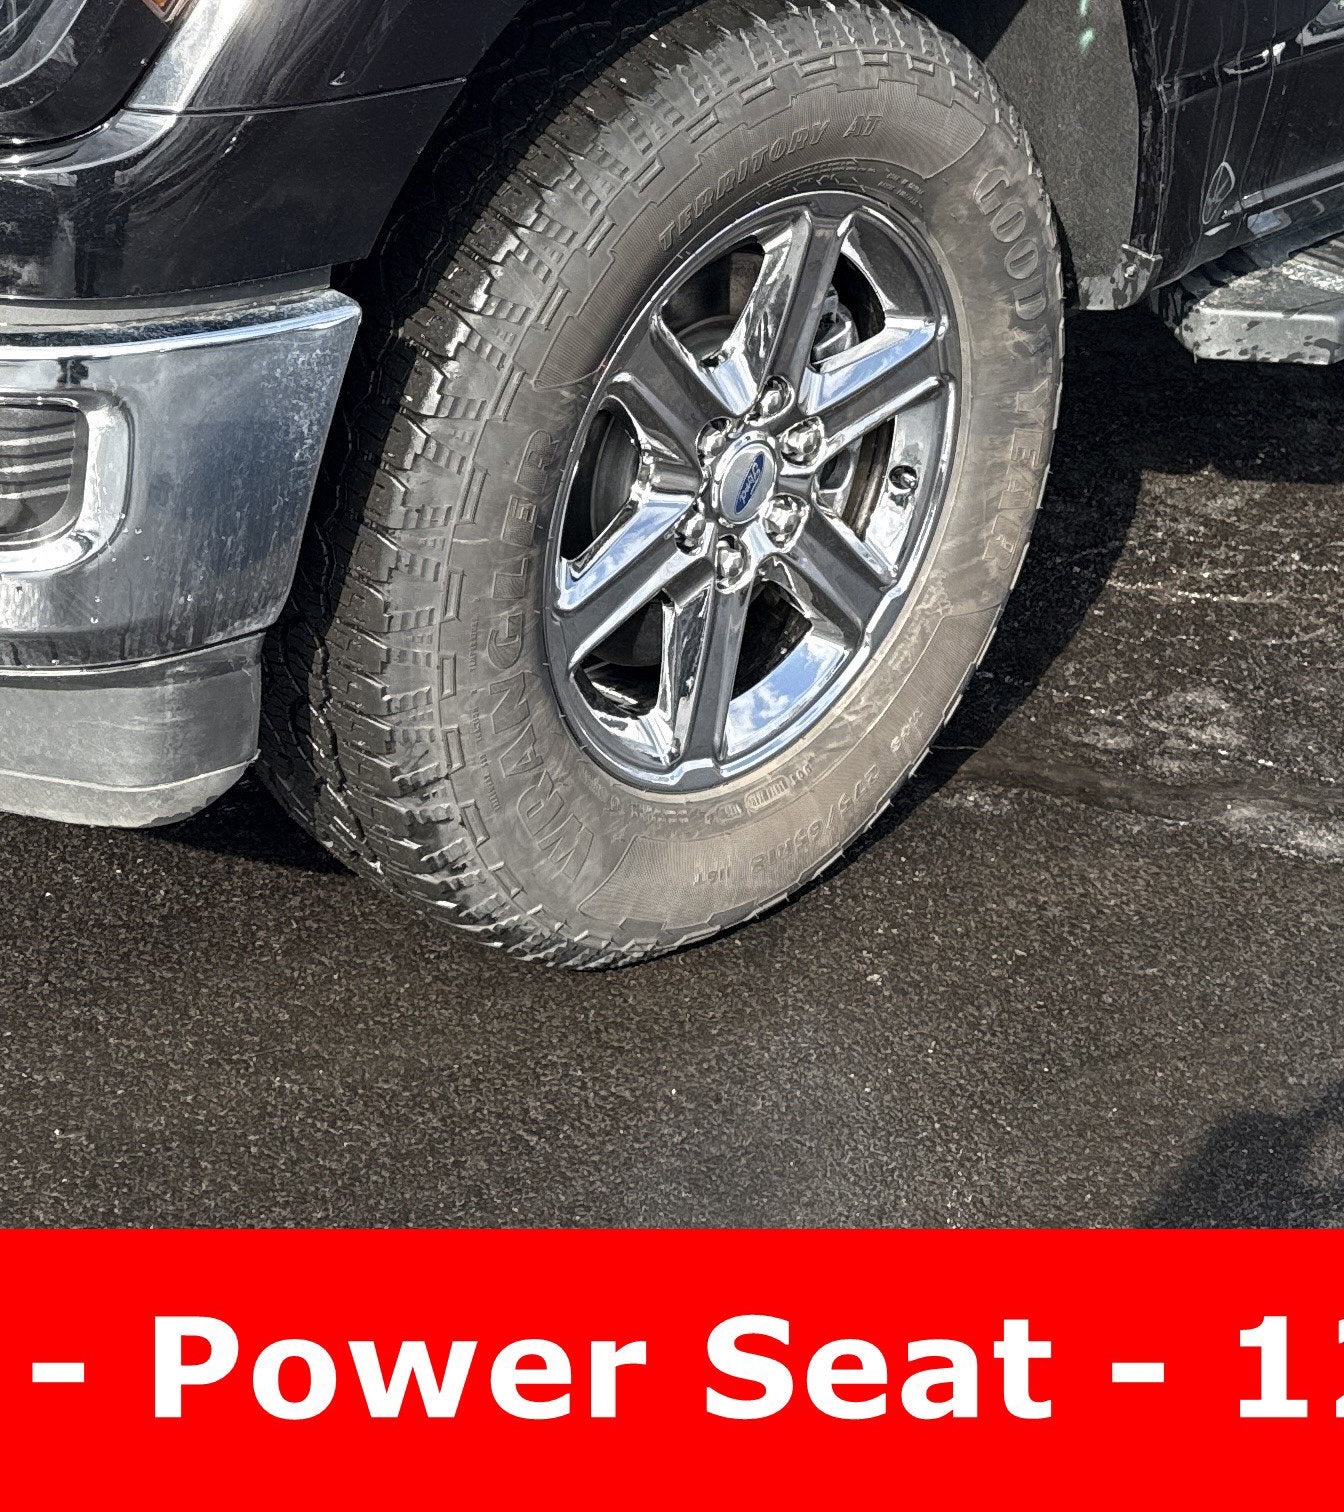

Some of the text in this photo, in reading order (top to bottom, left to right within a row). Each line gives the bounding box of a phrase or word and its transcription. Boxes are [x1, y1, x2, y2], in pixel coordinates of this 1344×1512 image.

[658, 119, 831, 251] TERRITORY
[843, 114, 884, 138] AT
[487, 428, 594, 882] WRANGLER
